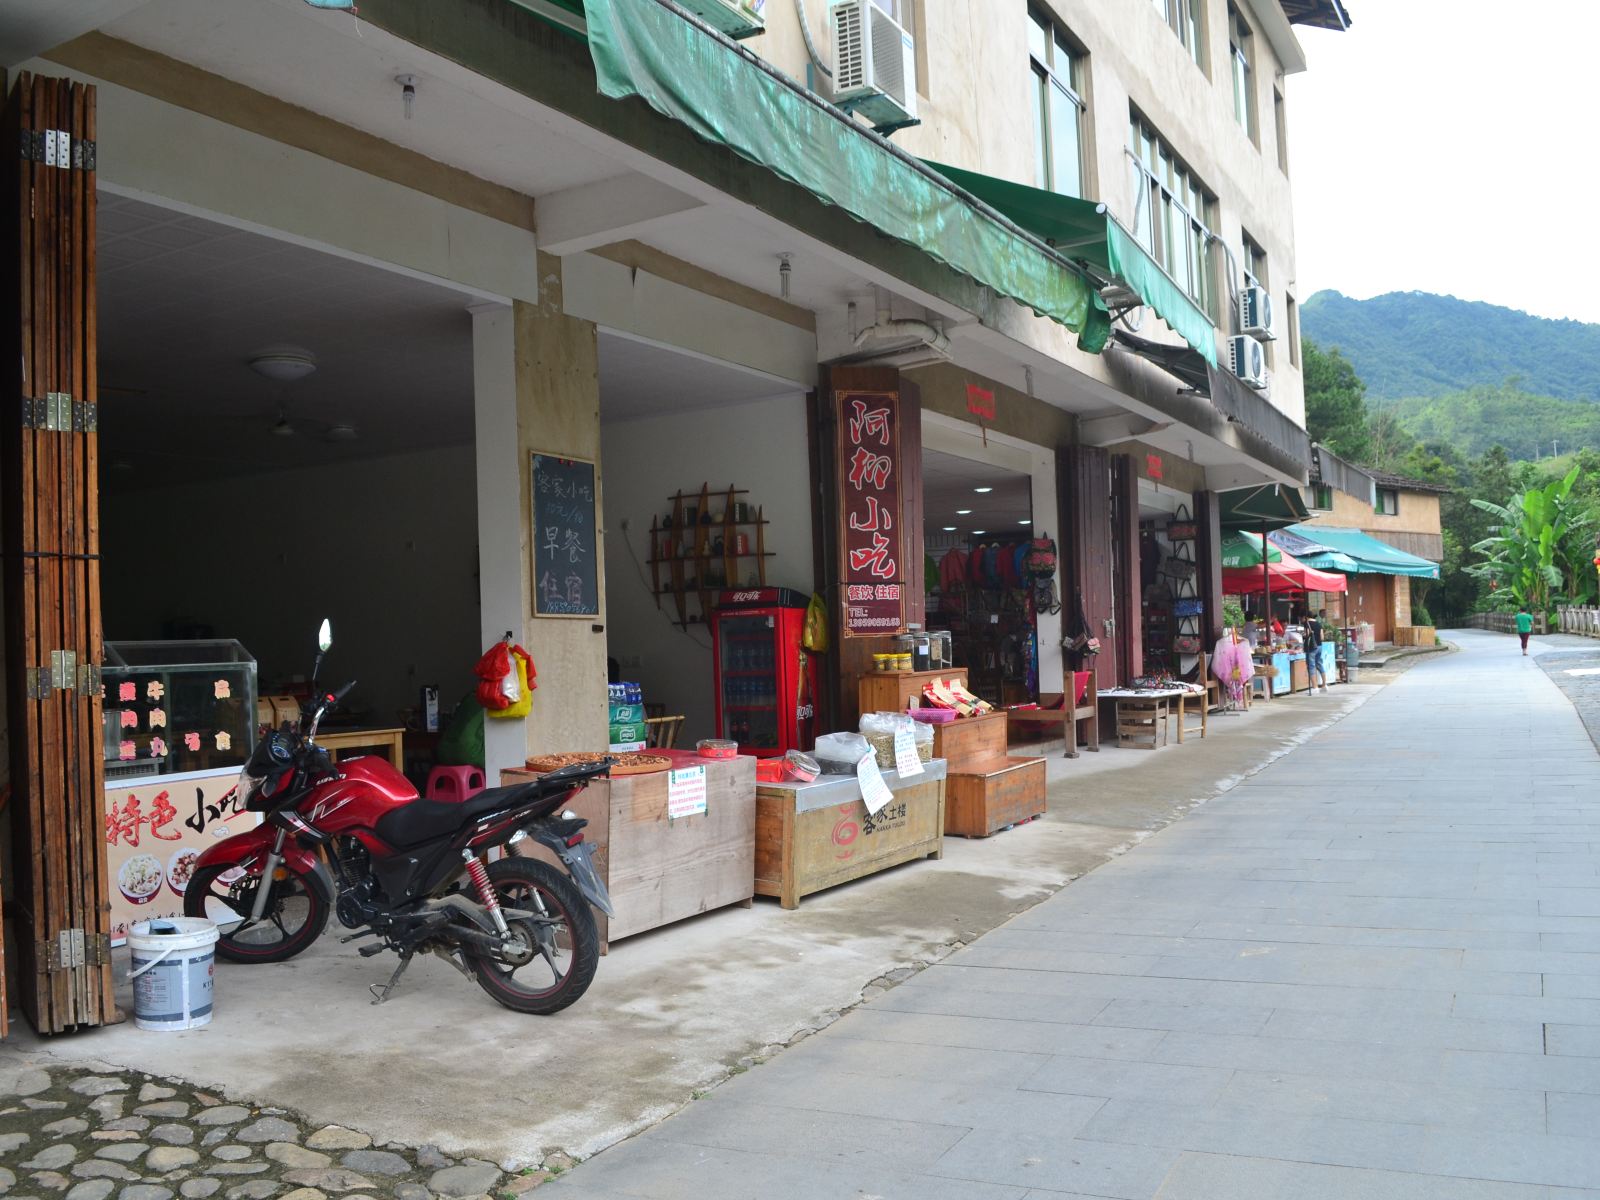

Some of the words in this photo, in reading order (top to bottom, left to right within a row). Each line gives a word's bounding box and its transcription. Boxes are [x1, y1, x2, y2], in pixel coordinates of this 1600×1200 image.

[538, 470, 593, 502] 客家小吃
[543, 526, 586, 563] 早餐
[539, 569, 583, 605] 住宿
[848, 584, 873, 600] 餐饮
[875, 584, 900, 600] 住宿
[848, 607, 868, 618] TEL:
